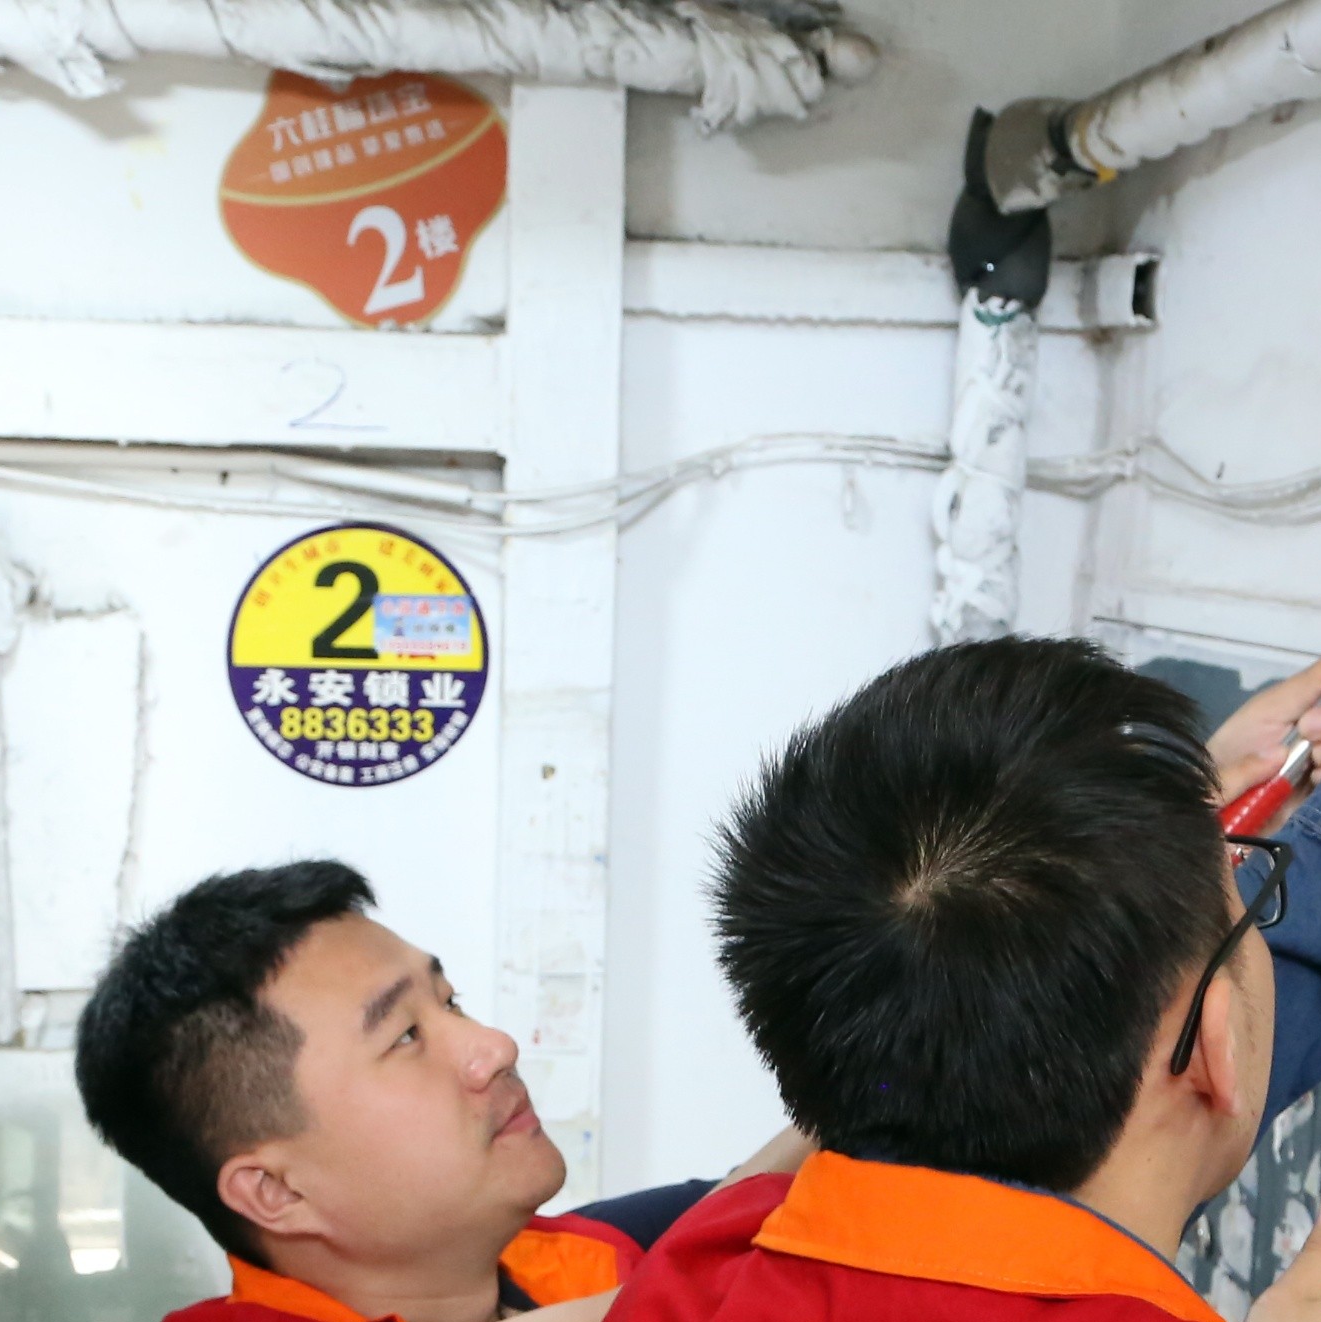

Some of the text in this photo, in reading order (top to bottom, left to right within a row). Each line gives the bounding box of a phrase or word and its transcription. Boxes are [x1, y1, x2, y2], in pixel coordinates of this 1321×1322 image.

[251, 668, 466, 708] 永安锁业
[279, 706, 435, 743] 8836333
